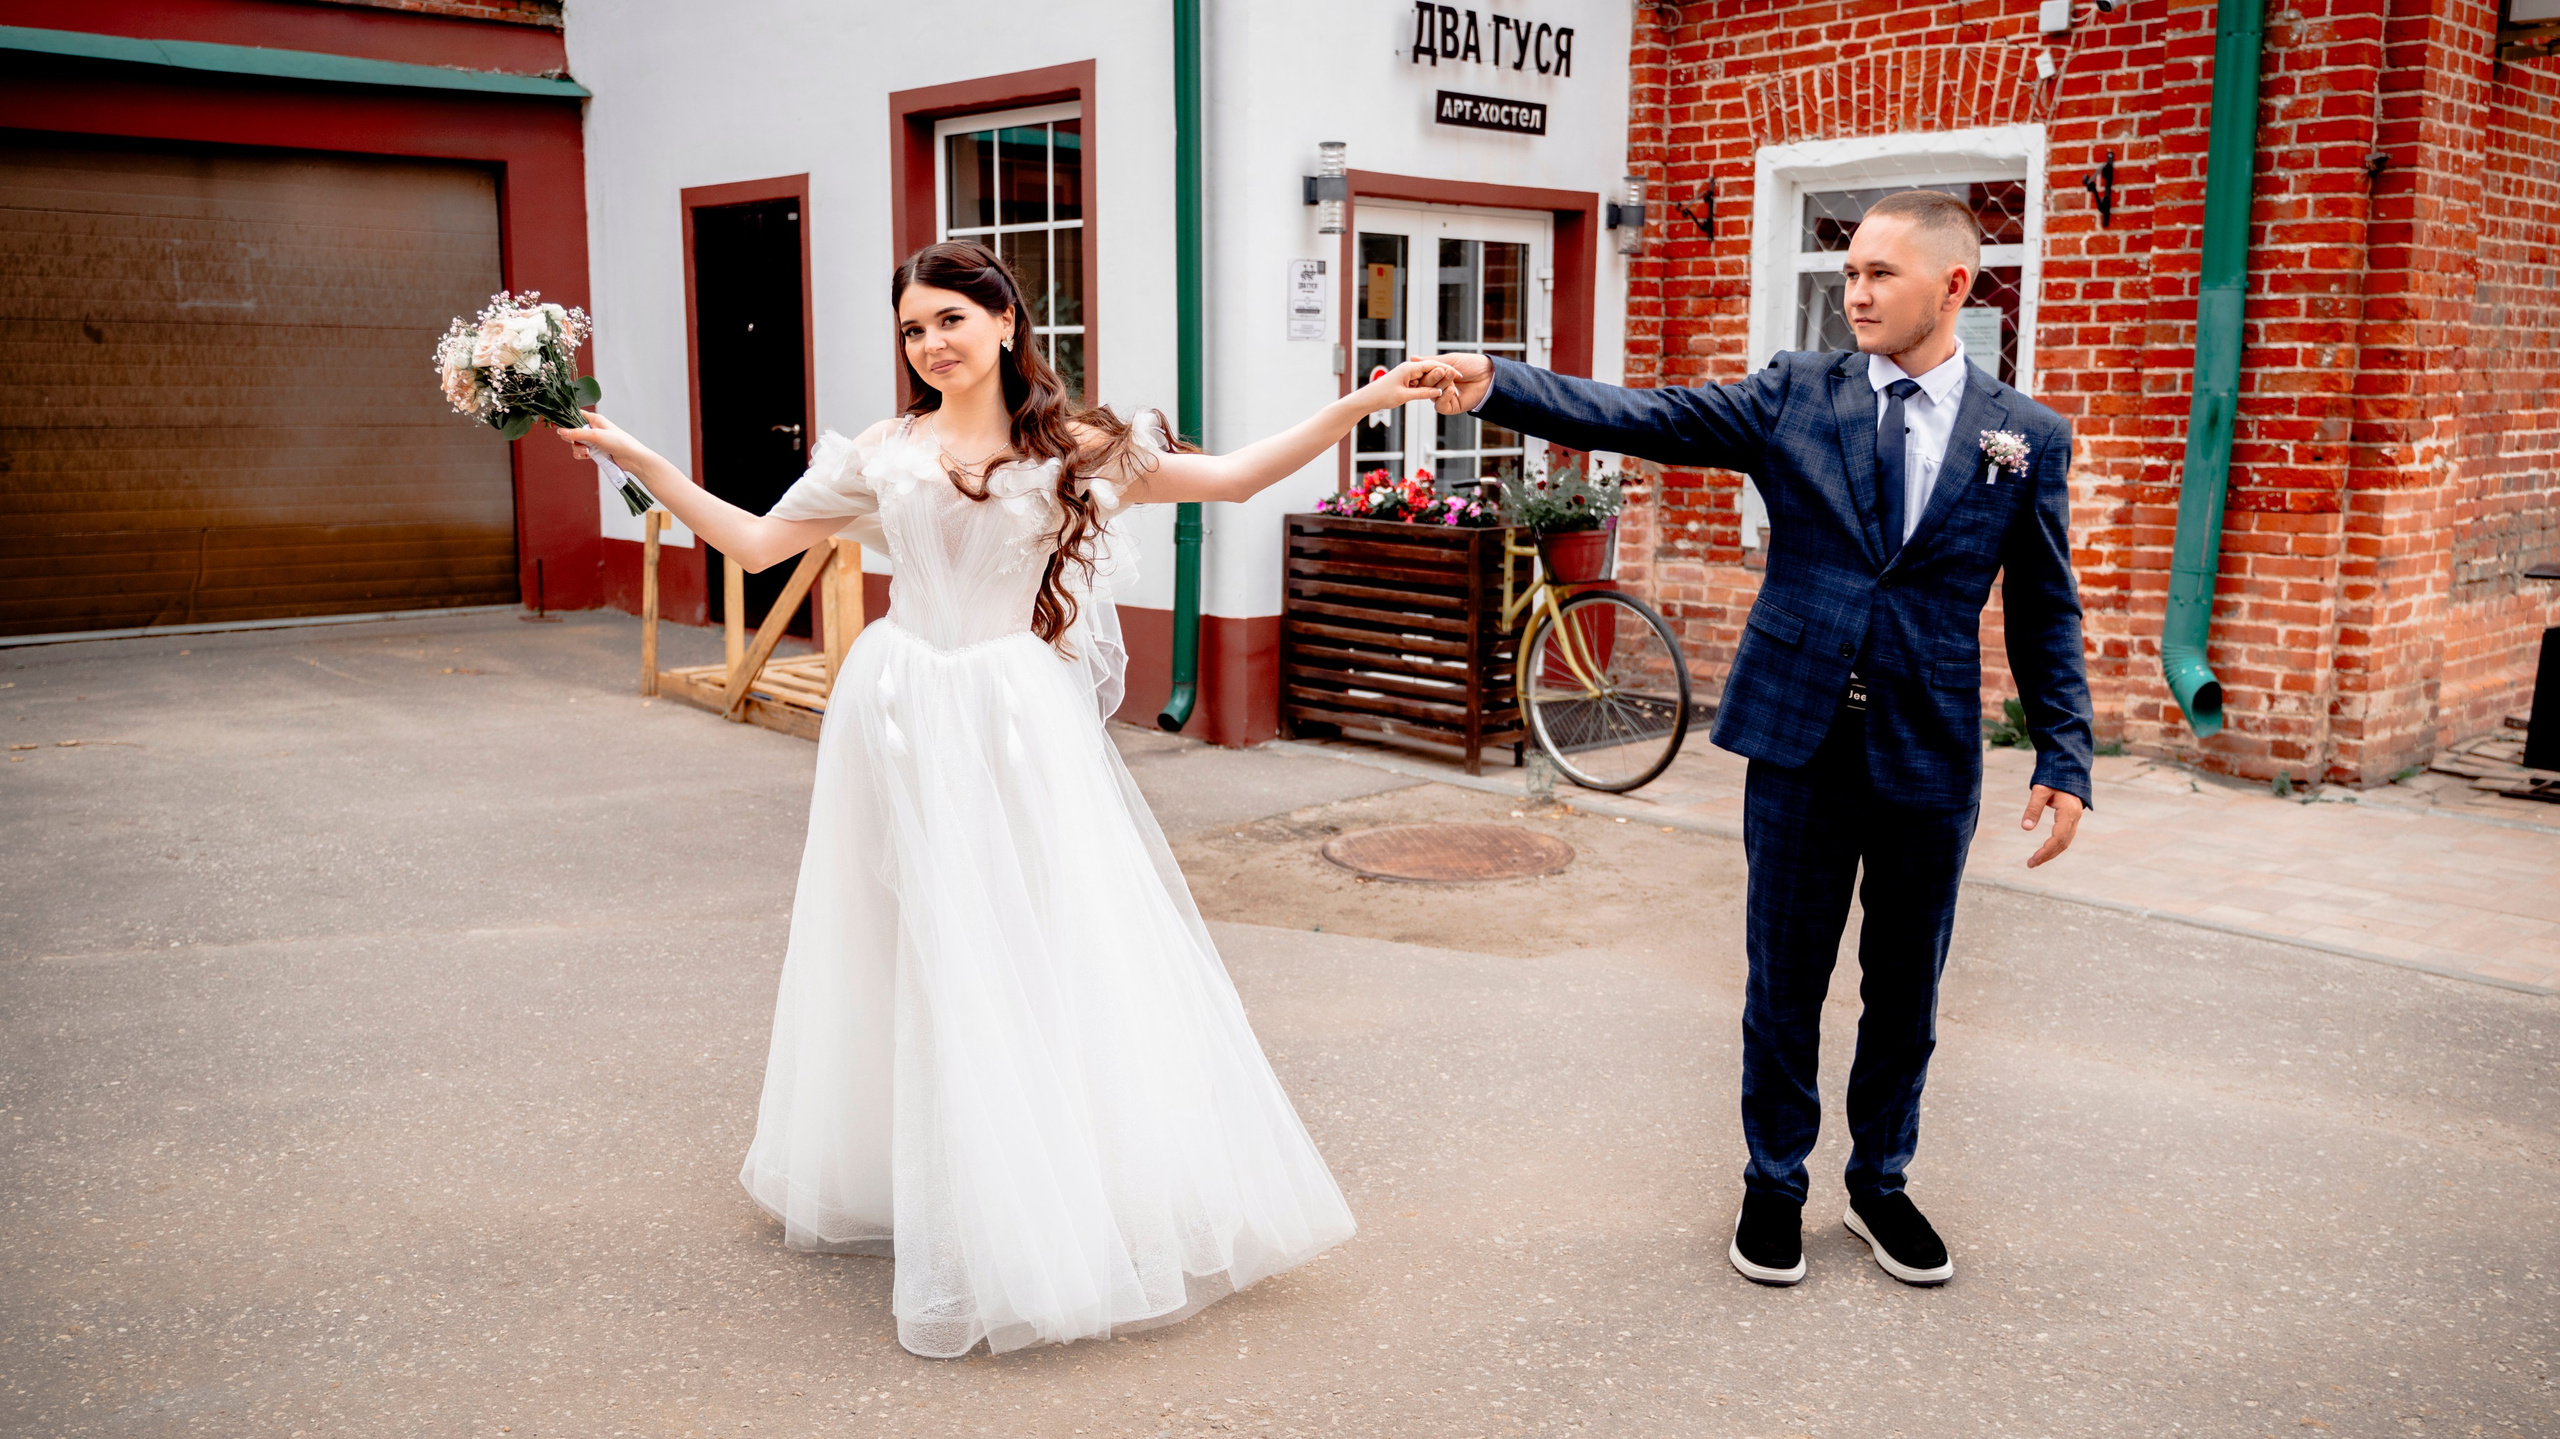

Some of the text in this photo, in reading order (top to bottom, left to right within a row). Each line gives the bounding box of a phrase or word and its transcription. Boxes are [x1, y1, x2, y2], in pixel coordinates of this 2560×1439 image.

[1412, 1, 1574, 77] ДВА ГУСЯ
[1848, 689, 1867, 702] Jee
